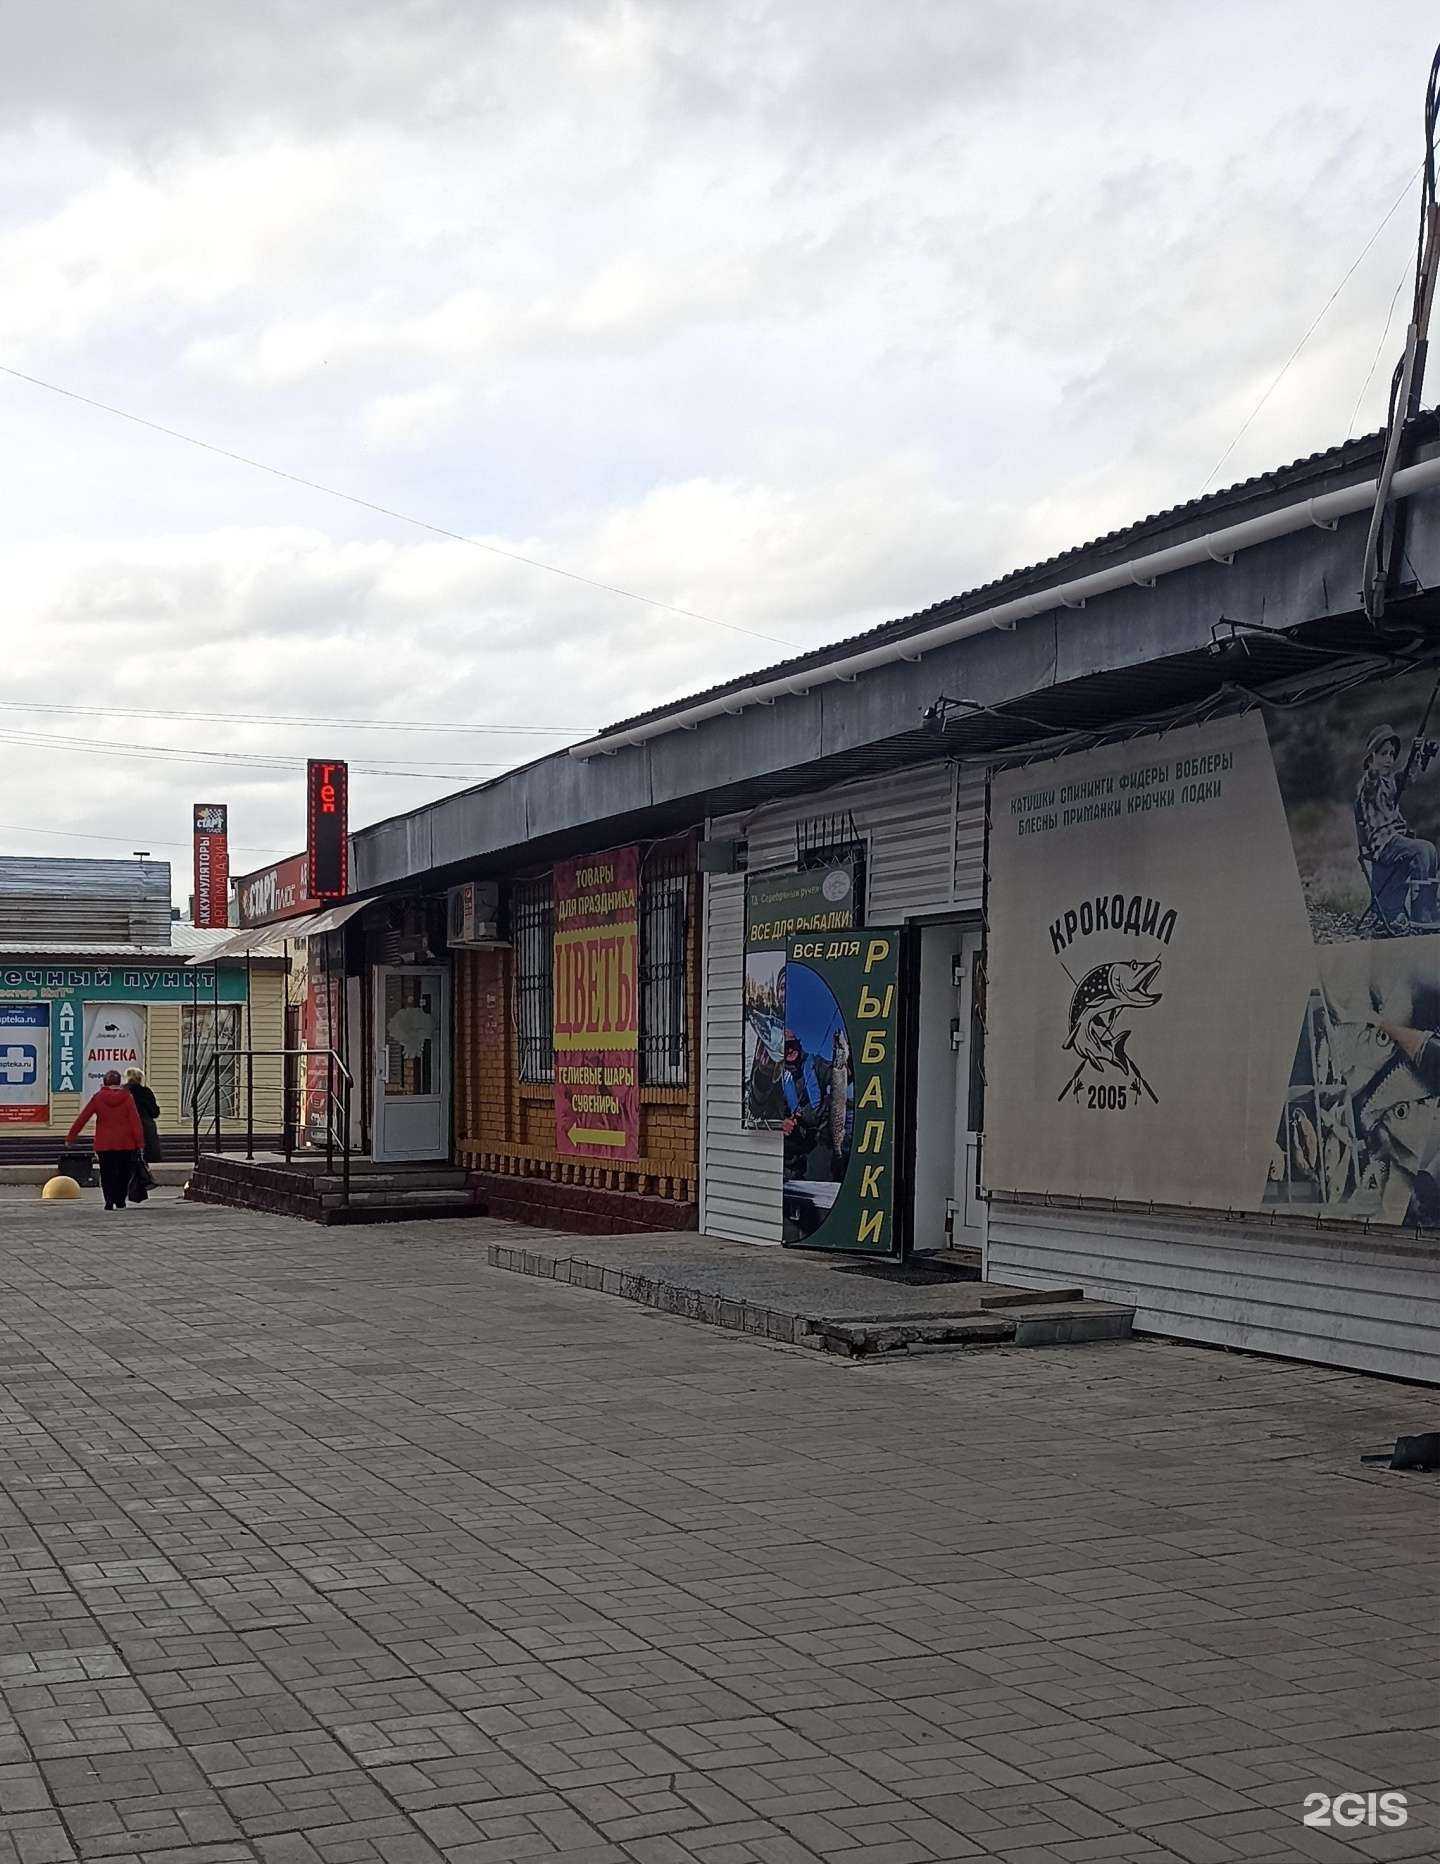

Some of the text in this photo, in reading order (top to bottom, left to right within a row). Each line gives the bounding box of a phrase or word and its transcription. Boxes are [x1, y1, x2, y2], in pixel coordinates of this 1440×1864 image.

[1010, 752, 1233, 814] КАТУШКИ СПИНИНГИ ФИДЕРЫ ВОБЛЕРЫ
[1018, 780, 1221, 836] БЛЕСНЫ ПРИМАНКИ КРЮЧКИ ЛОДКИ
[200, 836, 210, 925] АККУМУЛЯТОРЫ
[576, 864, 614, 888] ТОВАРЫ
[249, 869, 278, 919] СТАРТ
[558, 888, 635, 921] ДЛЯ ПРАЗДНИКА
[750, 910, 850, 941] ВСЕ ДЛЯ РЫБАЛКИ
[1048, 893, 1178, 955] КРОКОДИЛ
[793, 941, 860, 960] ВСЕ ДЛЯ
[0, 968, 216, 989] ечный пункт
[555, 935, 638, 1037] ЦВЕТЫ
[59, 1002, 75, 1091] АПТЕКА
[88, 1048, 137, 1061] АПТЕКА
[558, 1066, 634, 1086] ГЕЛИЕВЫЕ ШАРЫ
[856, 939, 895, 1243] РЫБАЛКИ
[572, 1094, 619, 1114] СУВЕНИРЫ
[1087, 1084, 1127, 1110] 2005
